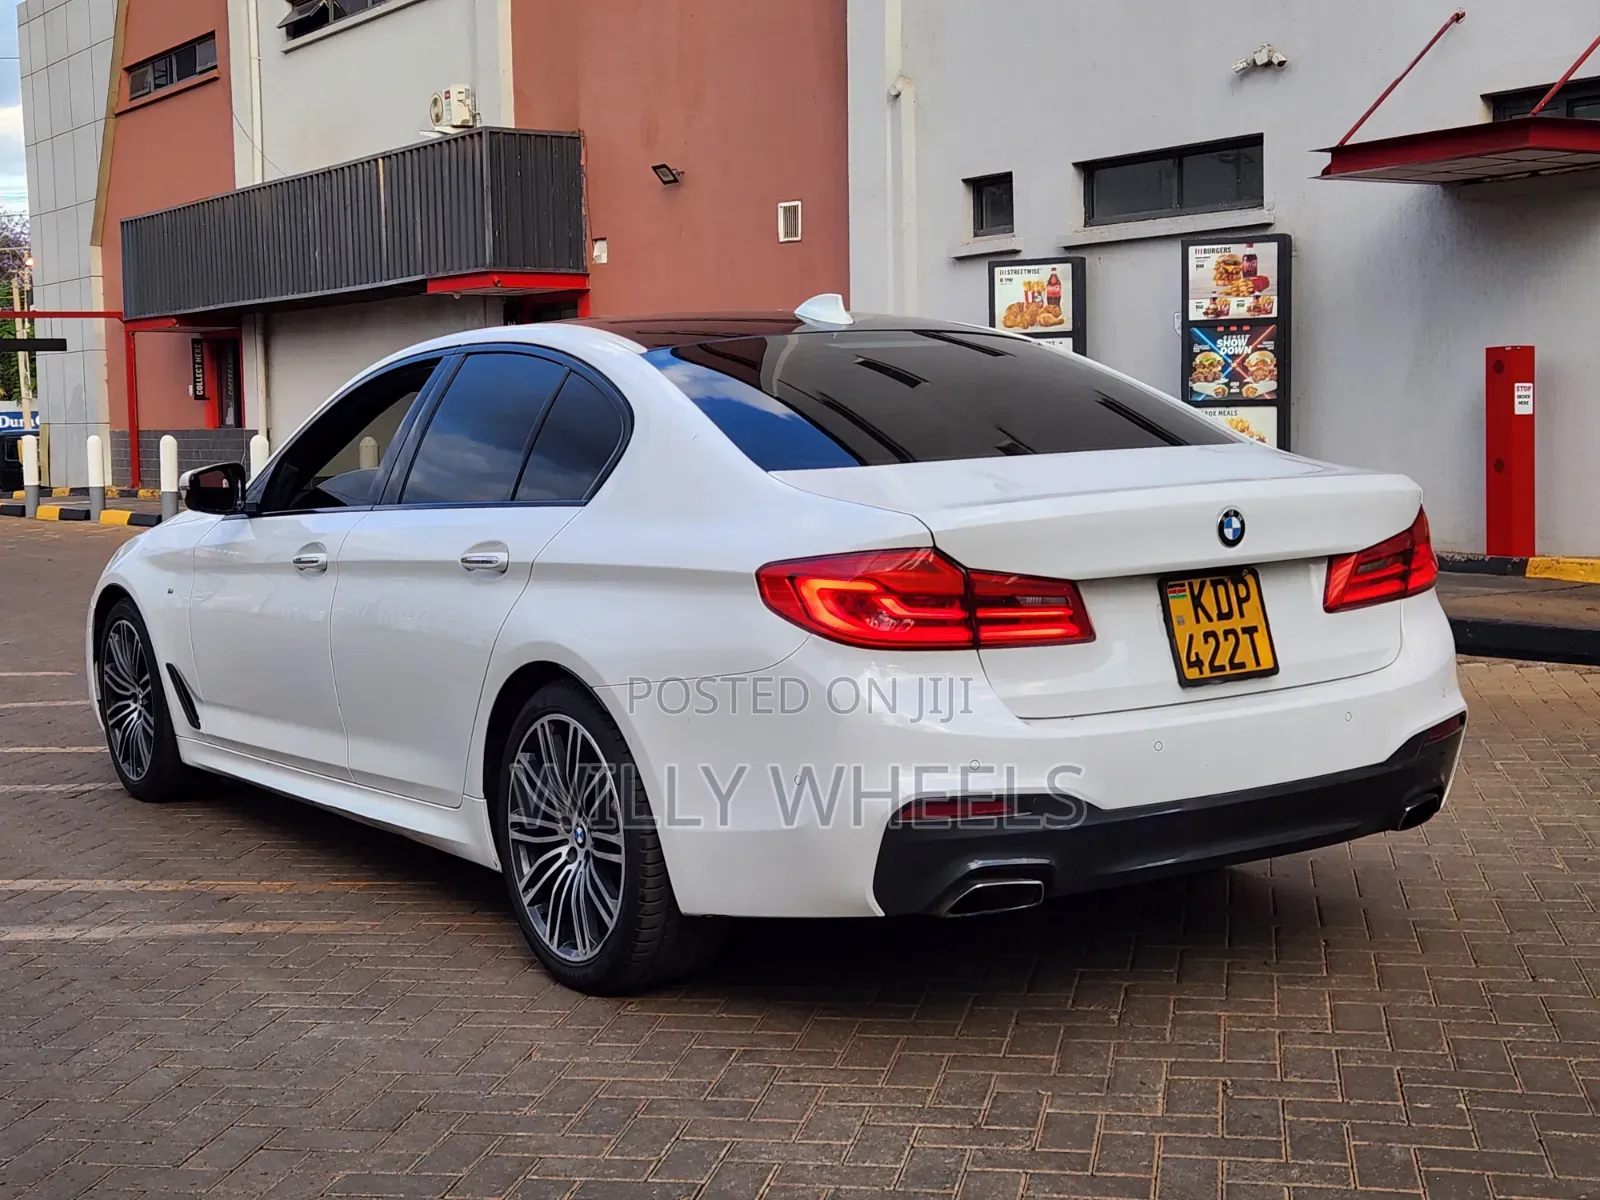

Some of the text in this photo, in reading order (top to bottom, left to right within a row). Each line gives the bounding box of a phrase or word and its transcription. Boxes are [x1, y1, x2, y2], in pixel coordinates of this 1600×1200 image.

[1216, 339, 1248, 347] SHOW
[1219, 346, 1252, 355] DOWN
[194, 343, 204, 396] COLLECT HERE
[1187, 578, 1251, 624] KDP
[1185, 625, 1261, 675] 422T
